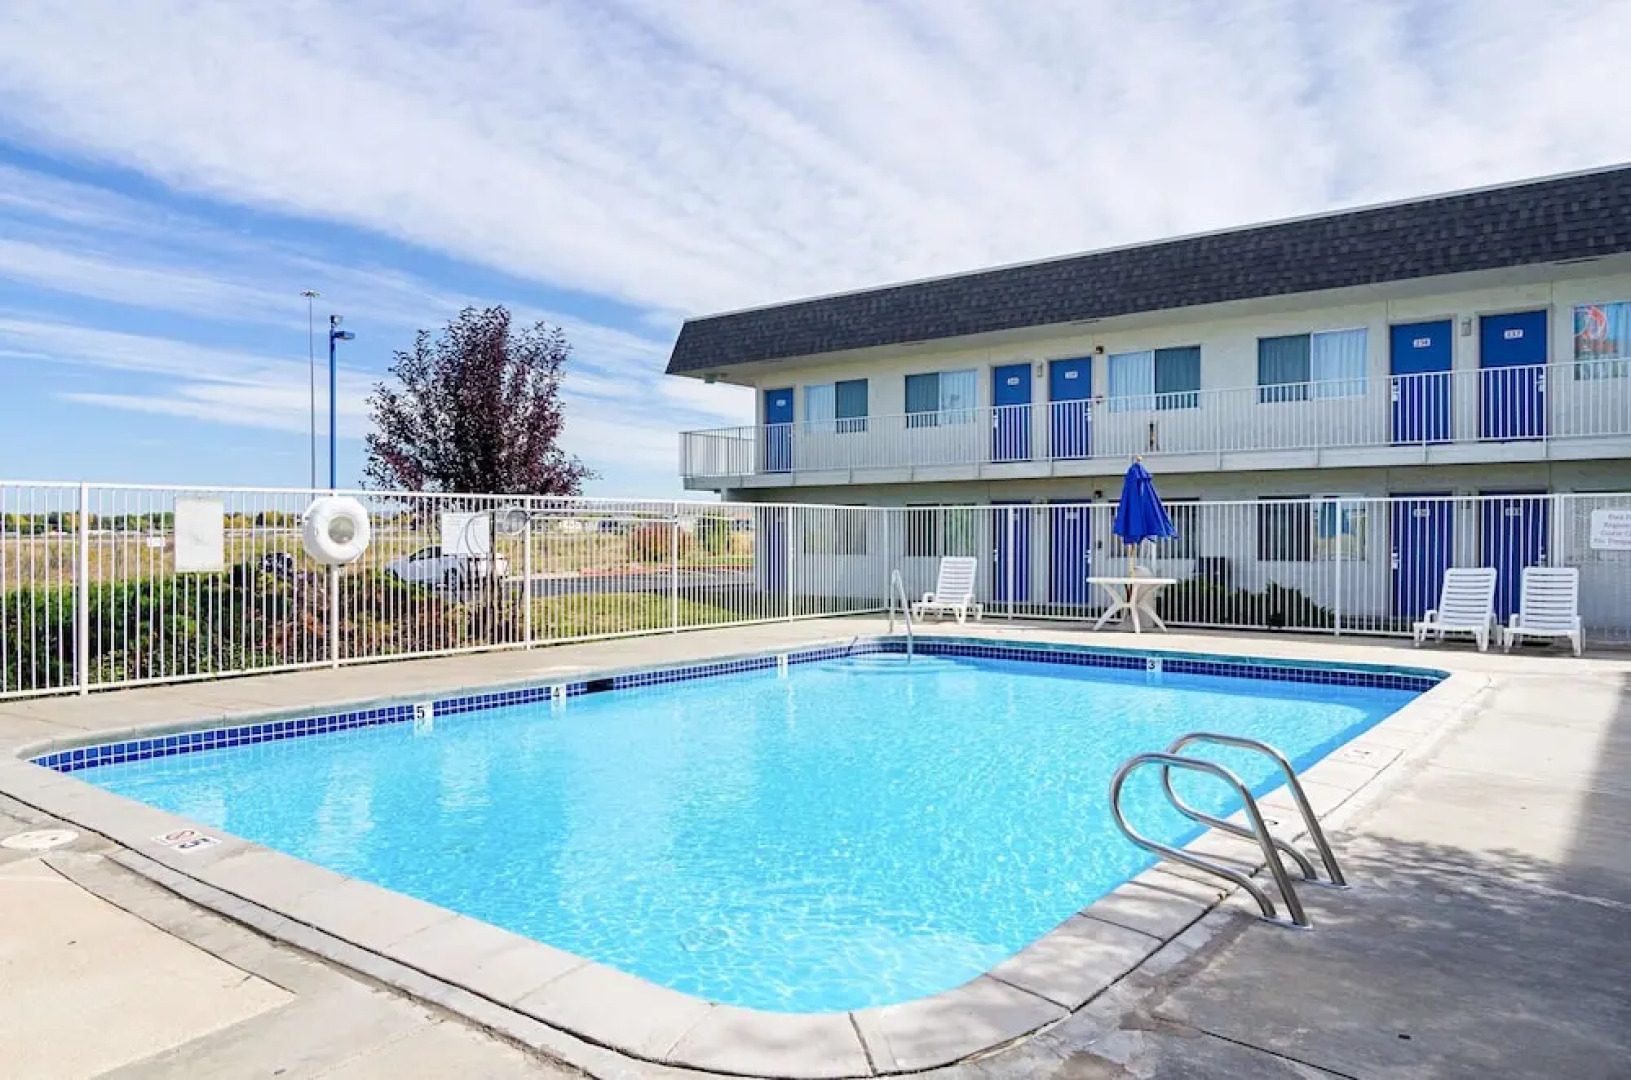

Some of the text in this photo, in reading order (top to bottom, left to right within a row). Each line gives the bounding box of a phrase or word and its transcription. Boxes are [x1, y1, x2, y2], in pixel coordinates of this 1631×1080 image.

[1148, 659, 1156, 670] 3
[552, 686, 560, 698] 4
[416, 705, 425, 719] 5
